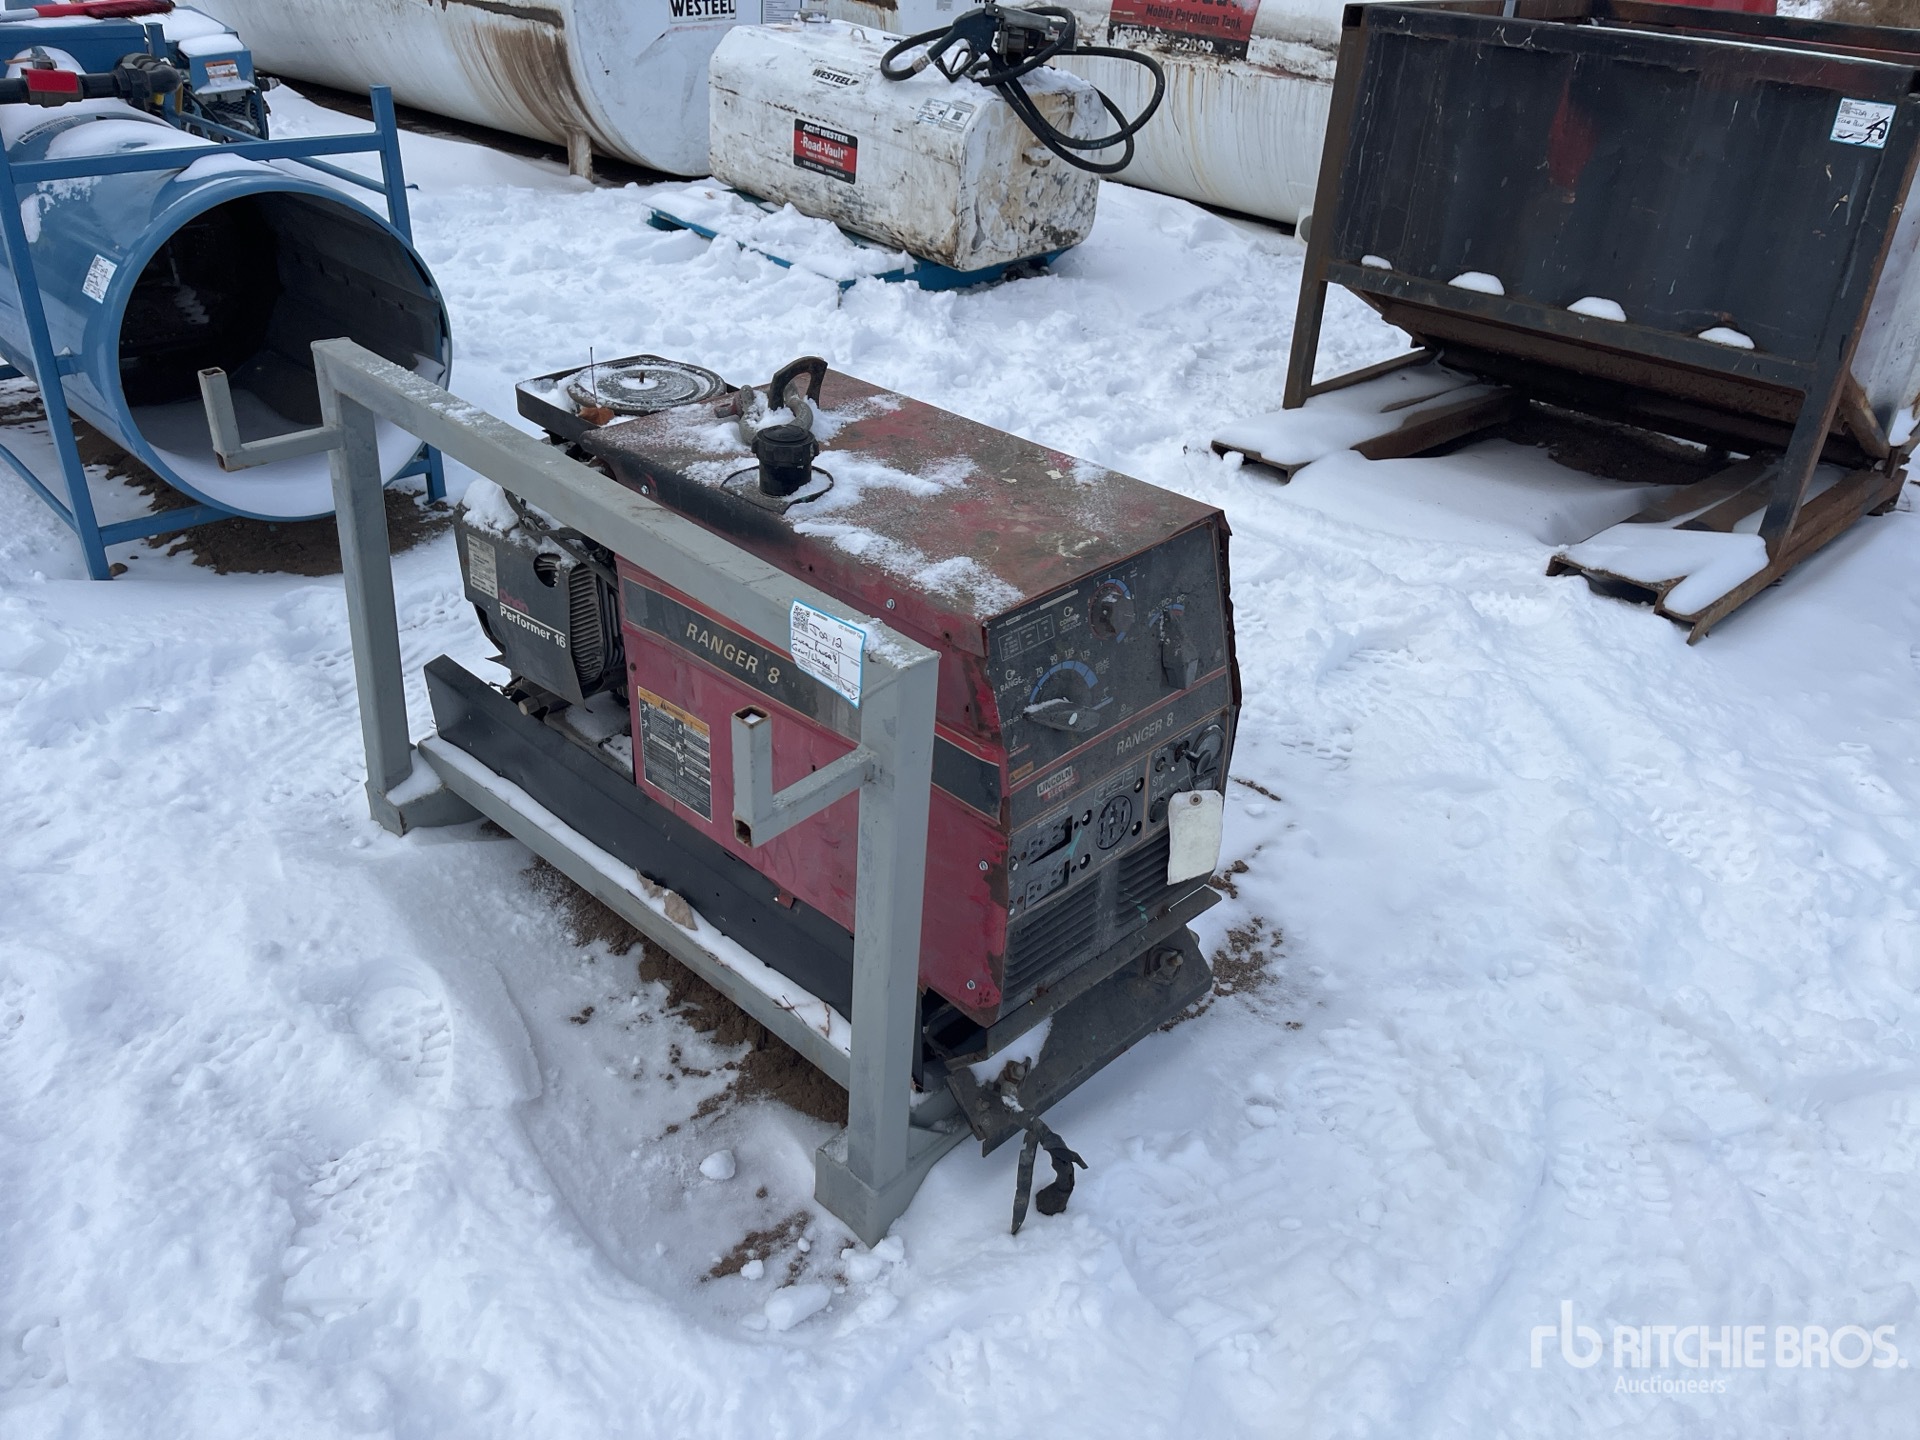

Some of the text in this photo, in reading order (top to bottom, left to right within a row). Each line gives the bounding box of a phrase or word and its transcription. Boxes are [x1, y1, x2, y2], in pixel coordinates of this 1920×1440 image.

[671, 0, 735, 17] WESTEEL
[1145, 4, 1242, 30] Mobile Petroleum Tank
[812, 68, 851, 86] WESTEEL
[820, 128, 849, 144] WESTEEL
[500, 607, 567, 649] Performer 16
[686, 622, 759, 674] RANGER
[767, 666, 780, 684] 8
[1035, 665, 1044, 675] 70
[999, 675, 1023, 693] RANGE
[1116, 718, 1163, 756] RANGER
[1166, 711, 1174, 727] 8
[1038, 768, 1072, 794] LINCOLN
[1047, 777, 1076, 799] ELECTRIC
